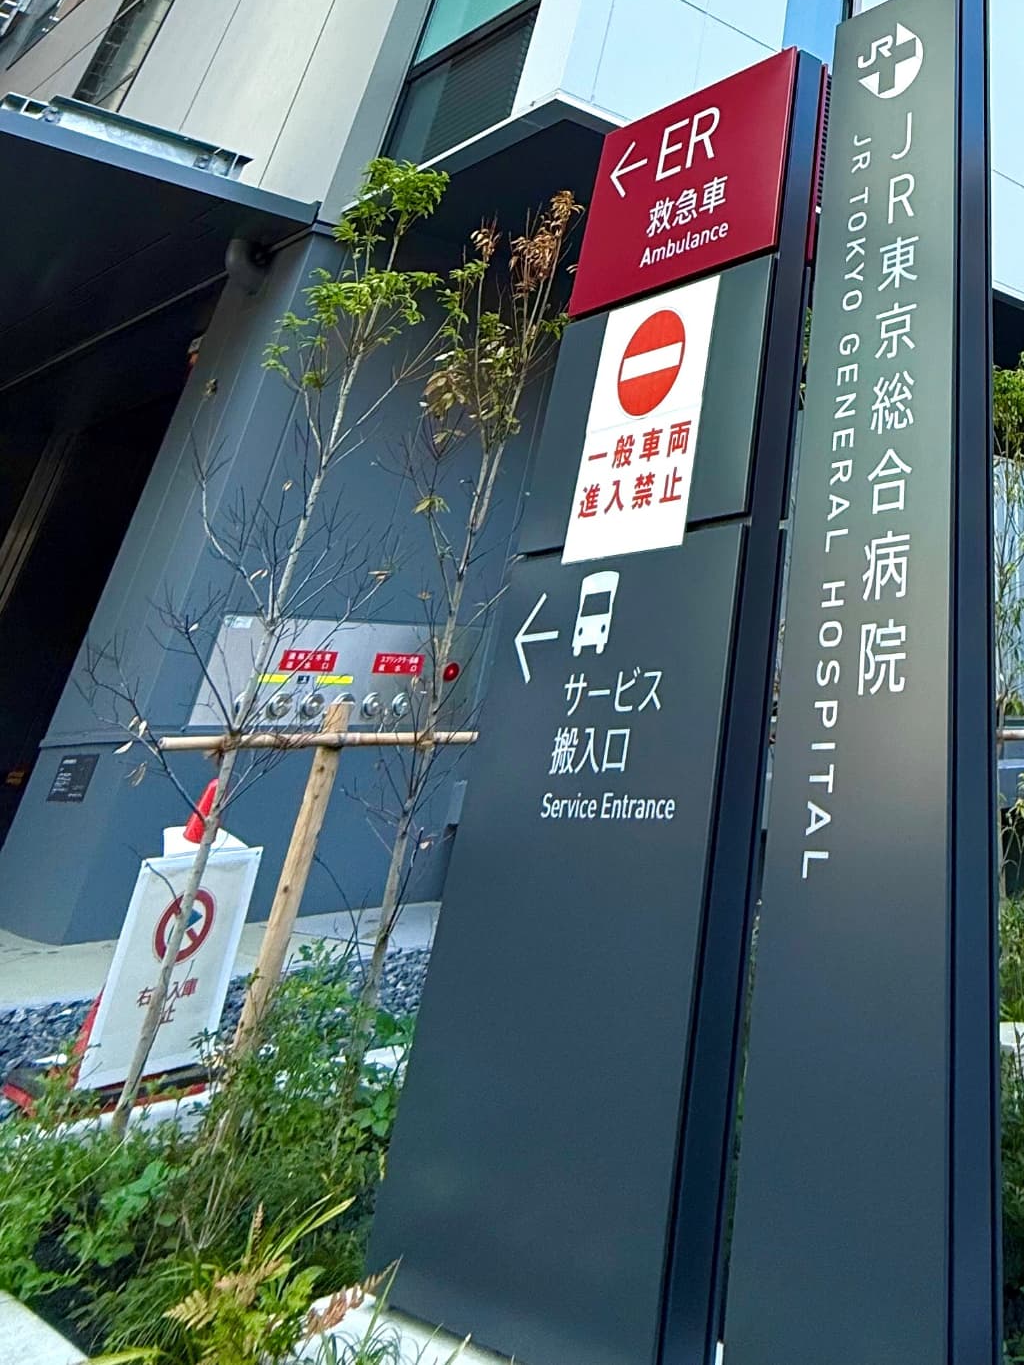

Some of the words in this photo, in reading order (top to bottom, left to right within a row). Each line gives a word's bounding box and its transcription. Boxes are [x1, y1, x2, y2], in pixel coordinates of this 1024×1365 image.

[857, 34, 893, 69] JR
[655, 106, 720, 182] ER
[850, 135, 872, 173] JR
[646, 176, 728, 238] 救急車
[639, 222, 729, 268] Ambulance
[841, 186, 870, 312] TOKYO
[857, 111, 920, 696] JR東京総合病院
[588, 420, 692, 469] 一般車両
[824, 334, 860, 553] GENERAL
[577, 466, 682, 519] 進入禁止
[564, 666, 663, 716] サービス
[549, 727, 631, 775] 搬入口
[801, 581, 846, 879] HOSPITAL
[540, 792, 597, 820] Service
[600, 792, 675, 820] Entrance
[136, 978, 199, 1008] 右入庫
